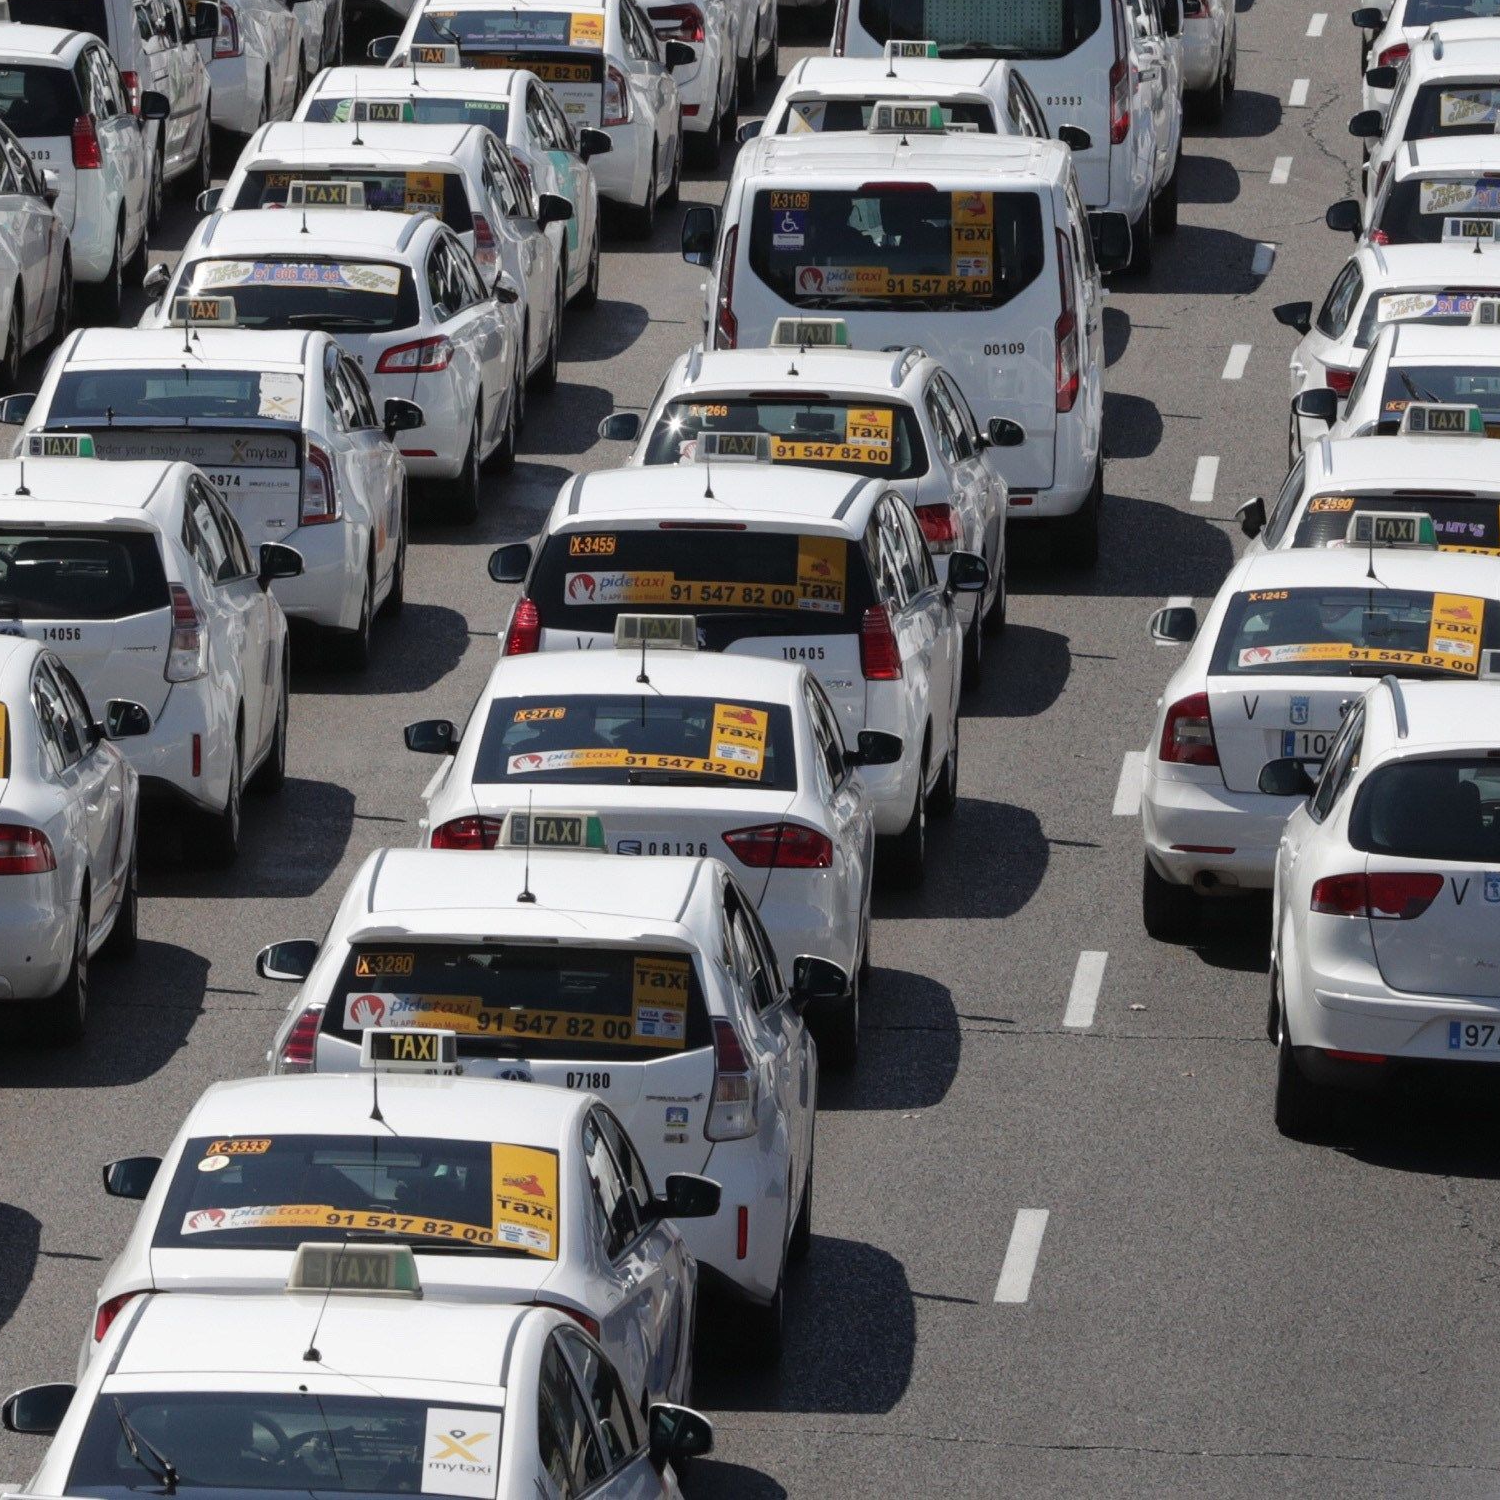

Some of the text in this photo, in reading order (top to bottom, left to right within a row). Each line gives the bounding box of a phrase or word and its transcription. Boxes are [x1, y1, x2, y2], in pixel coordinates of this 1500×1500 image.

[421, 48, 444, 62] TAXI
[902, 43, 926, 56] TAXI
[371, 104, 398, 119] TAXI
[896, 109, 926, 126] TAXI
[306, 185, 346, 202] TAXI
[771, 192, 809, 209] X-3109
[954, 227, 993, 241] Taxi
[1464, 222, 1492, 236] TAXI
[826, 269, 993, 294] pidetaxi 91 547 82 00
[189, 302, 219, 319] TAXI
[799, 325, 831, 342] TAXI
[984, 342, 1025, 357] 00109
[1431, 411, 1464, 429] TAXI
[850, 426, 889, 440] Taxi
[45, 438, 76, 453] TAXI
[720, 437, 756, 453] TAXI
[776, 445, 888, 462] 91 547 82 00
[246, 447, 288, 462] mytaxi
[1311, 498, 1353, 512] X-2590
[1377, 521, 1414, 539] TAXI
[571, 536, 616, 554] X-3455
[600, 574, 666, 591] pidetaxi
[670, 584, 693, 601] 91
[700, 586, 736, 603] 547
[742, 587, 765, 604] 82
[772, 589, 795, 606] 00
[800, 583, 842, 600] Taxi
[1248, 590, 1289, 603] X-1245
[43, 626, 81, 641] 14056
[640, 619, 679, 638] TAXI
[1434, 621, 1478, 636] Taxi
[782, 646, 825, 661] 10405
[1348, 649, 1476, 674] 91 547 82 00
[515, 708, 565, 722] X-2716
[1243, 695, 1260, 721] V
[716, 726, 763, 741] Taxi
[546, 750, 759, 779] pidetaxi 91 547 82 00
[536, 820, 580, 842] TAXI
[649, 841, 708, 858] 08136
[1451, 877, 1470, 906] V
[357, 955, 413, 975] X-3280
[636, 969, 688, 991] Taxi
[389, 998, 632, 1039] pidetaxi 91 547 82 00
[391, 1034, 438, 1060] TAXI
[566, 1072, 610, 1090] 07180
[208, 1139, 271, 1155] X-3333
[500, 1200, 553, 1222] Taxi
[231, 1206, 322, 1222] pidetaxi
[326, 1212, 354, 1227] 91
[367, 1215, 413, 1231] 547
[423, 1221, 453, 1237] 82
[462, 1228, 494, 1244] 00
[334, 1257, 389, 1284] TAXI
[429, 1460, 491, 1478] mytaxi
